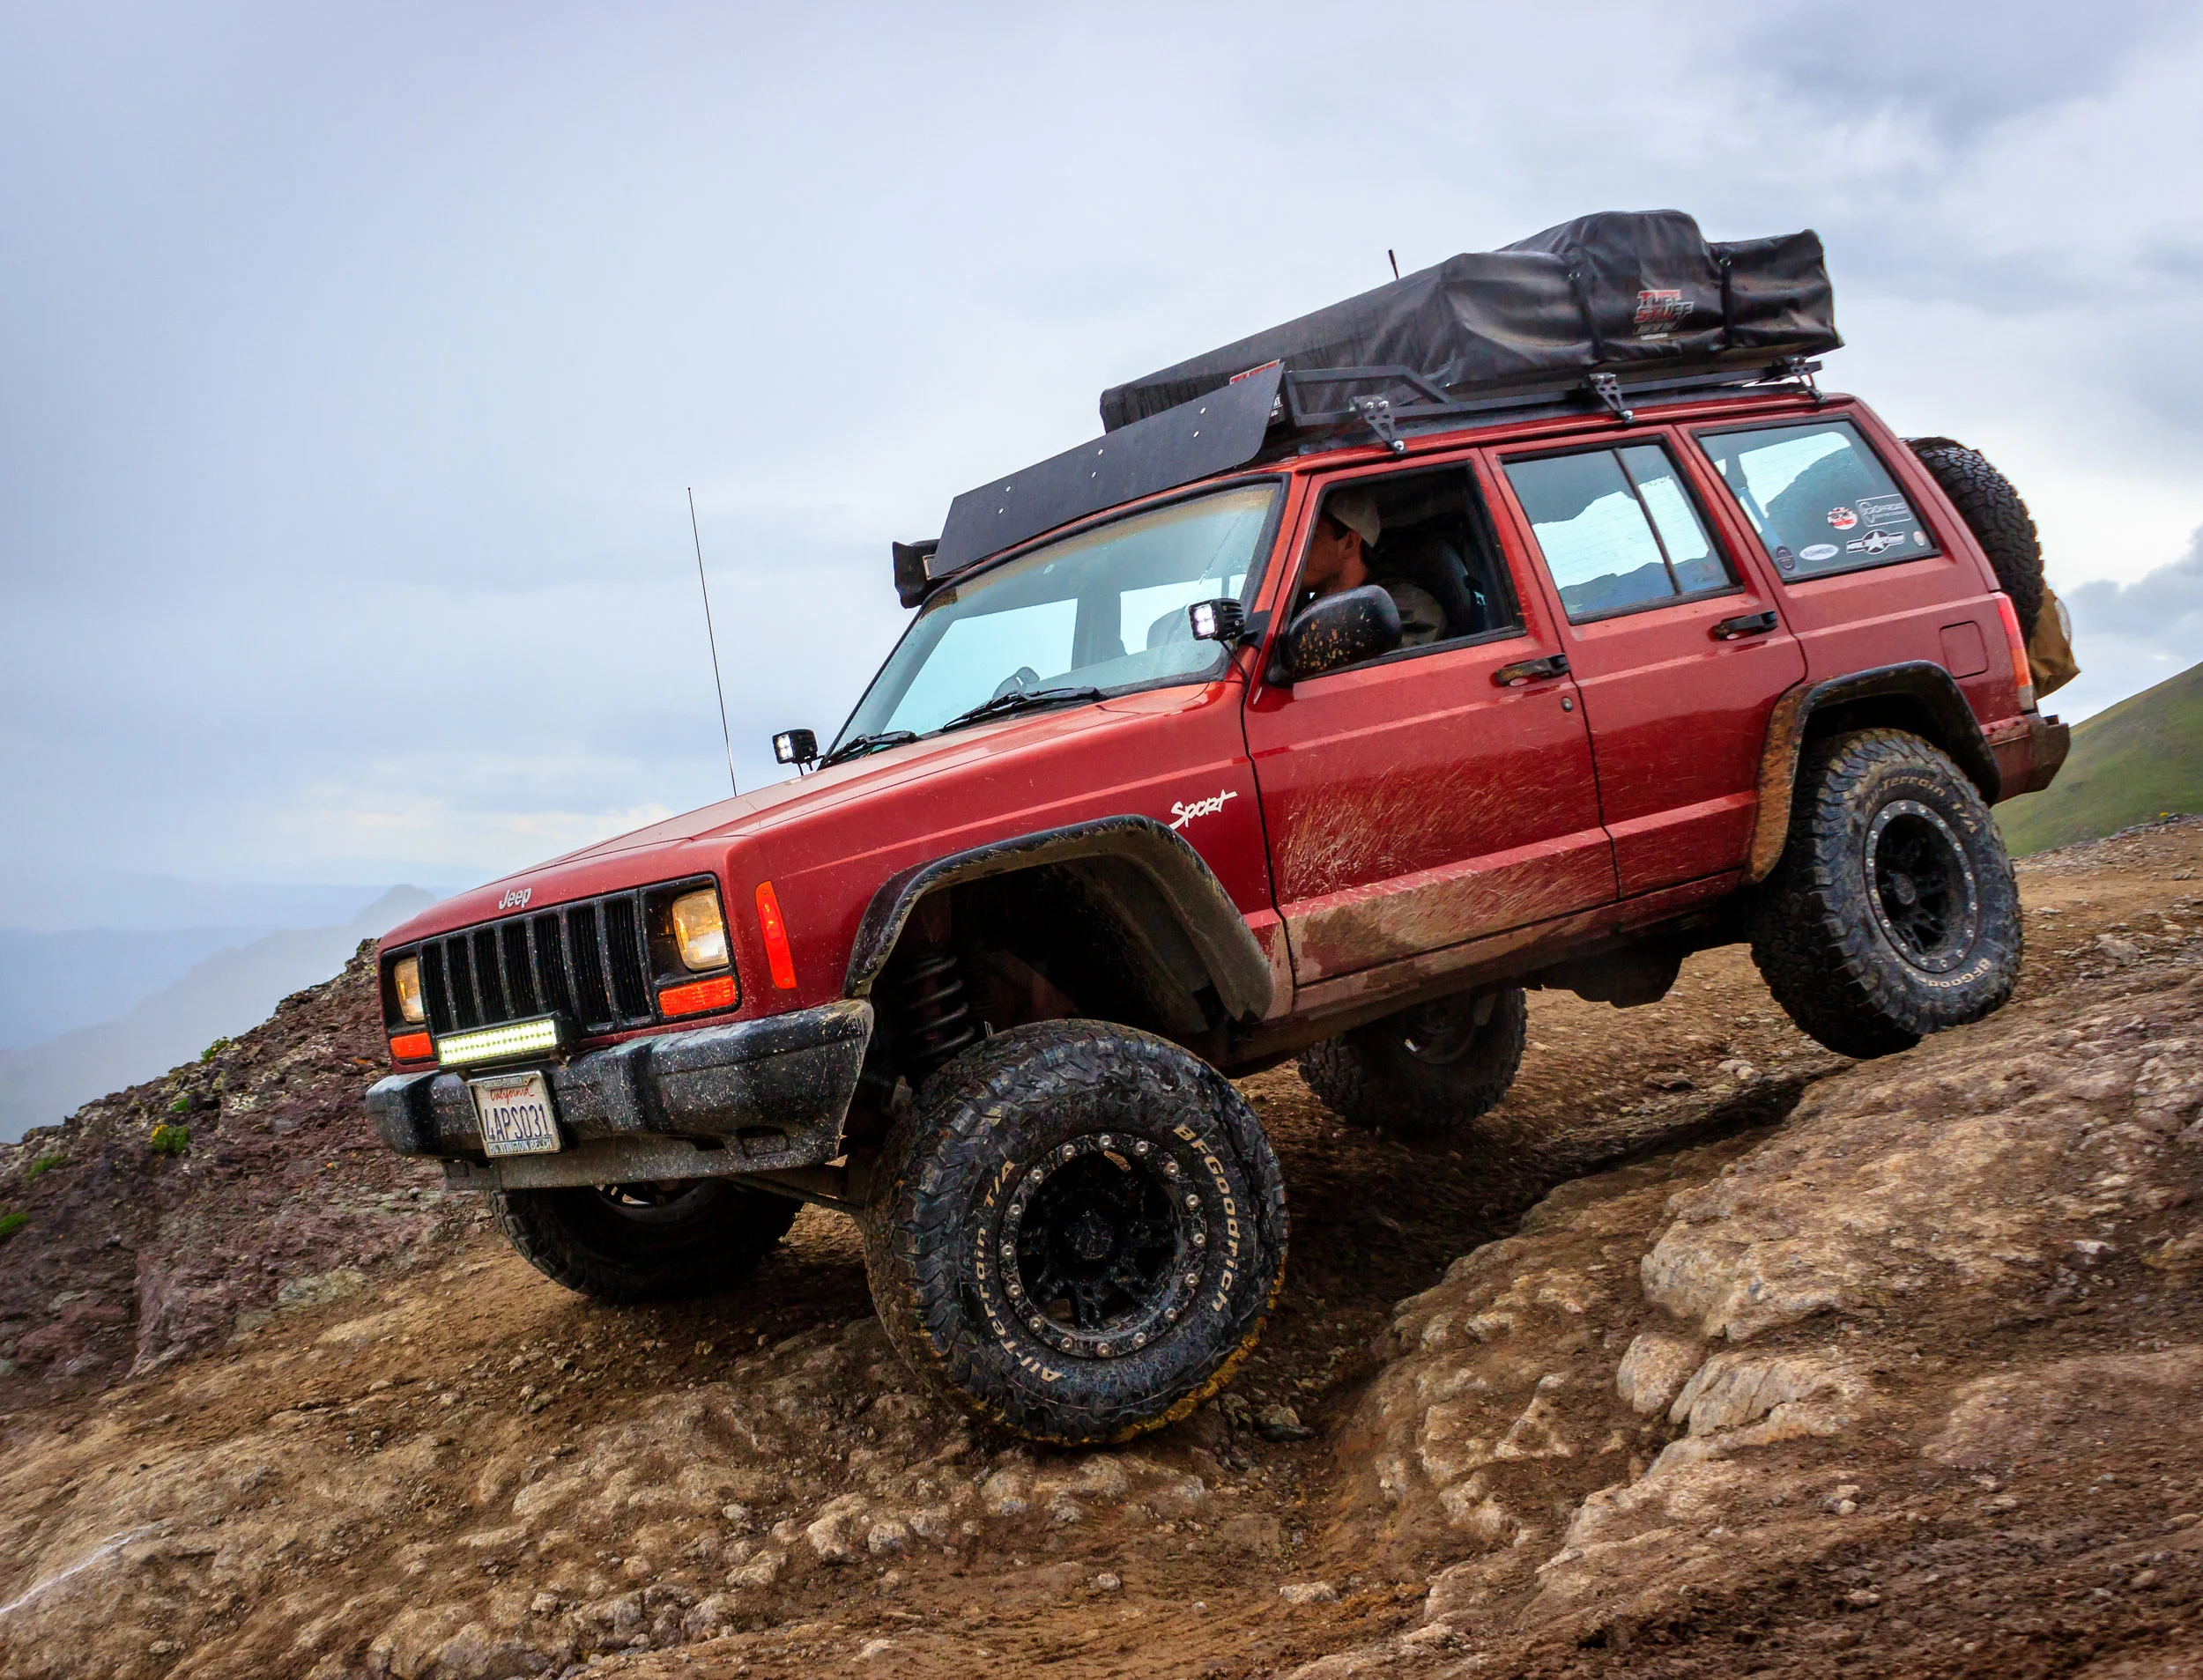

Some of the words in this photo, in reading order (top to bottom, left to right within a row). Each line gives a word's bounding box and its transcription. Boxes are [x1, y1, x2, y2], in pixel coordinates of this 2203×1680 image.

[1633, 300, 1695, 323] STUFF
[498, 887, 531, 910] Jeep
[490, 1087, 536, 1105] California
[485, 1103, 553, 1141] 4APS031
[983, 1159, 1016, 1208] T/A
[1172, 1124, 1241, 1312] BFGoodrich
